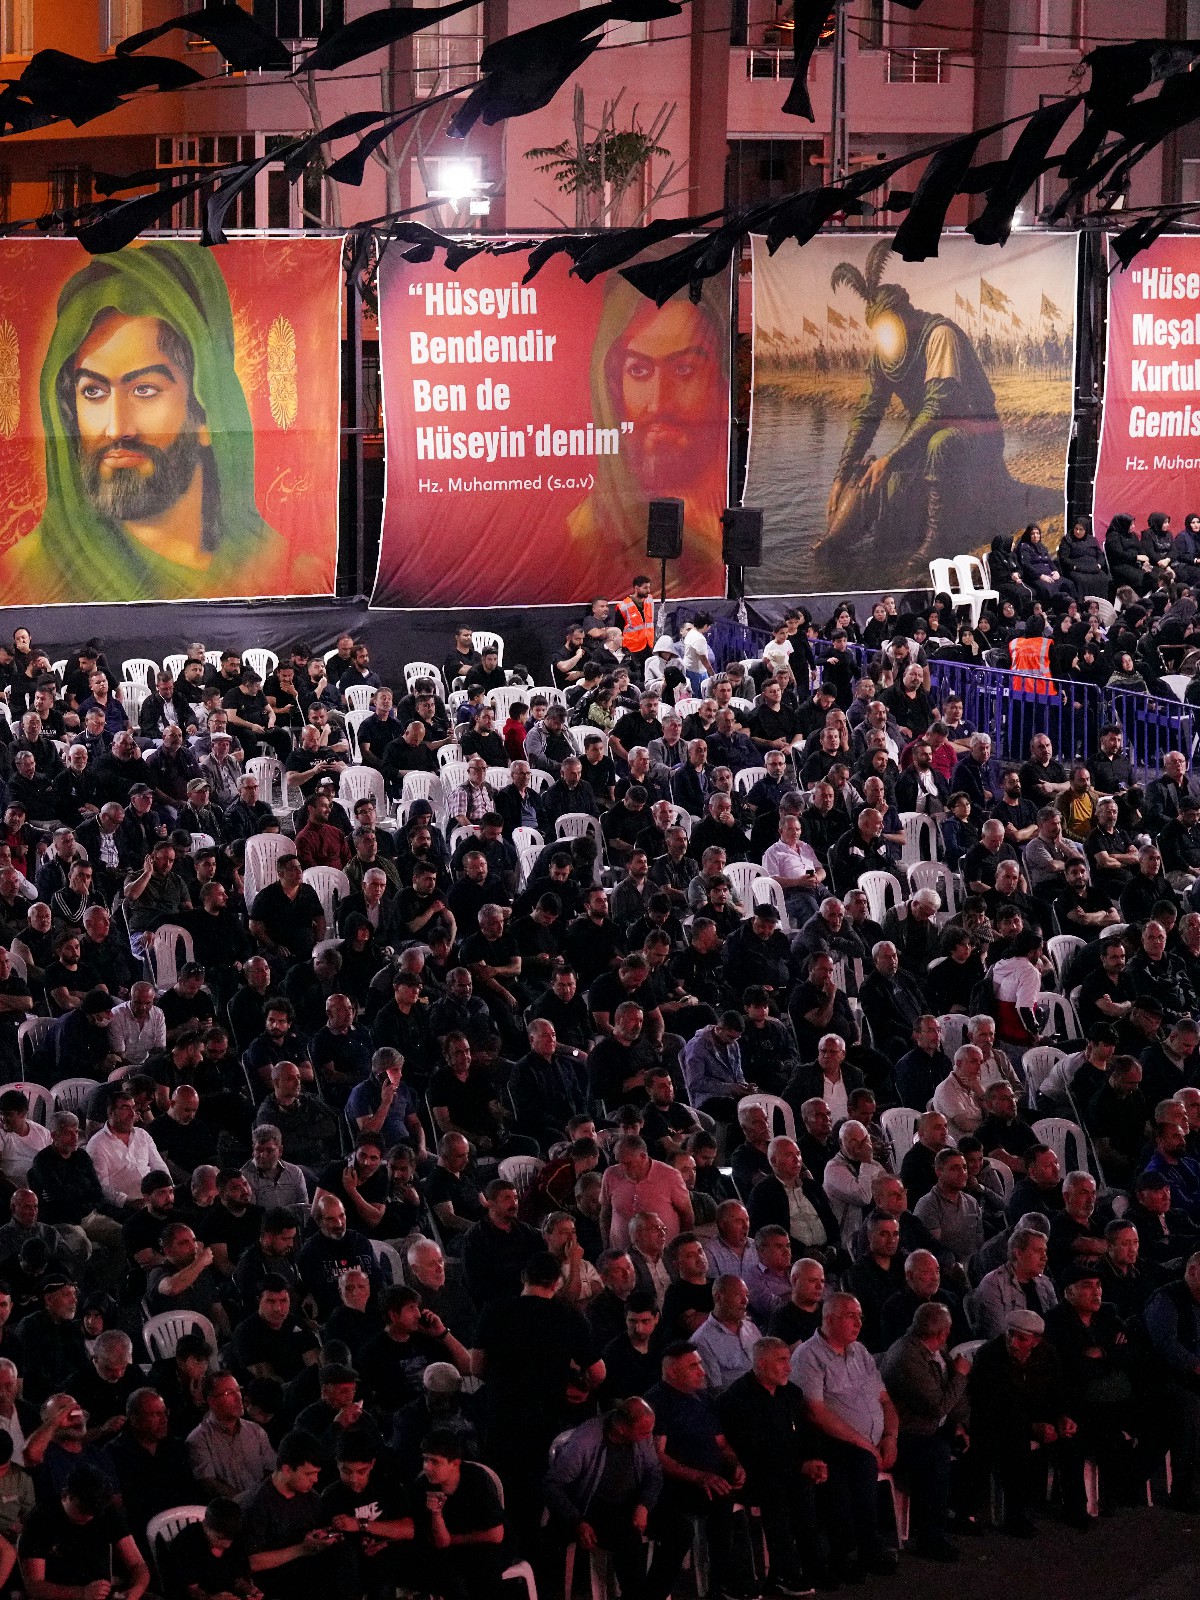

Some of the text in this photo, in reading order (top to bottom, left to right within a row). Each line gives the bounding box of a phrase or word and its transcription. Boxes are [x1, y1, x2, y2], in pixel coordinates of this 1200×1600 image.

[408, 281, 538, 319] “Hüseyin
[409, 329, 557, 365] Bendendir
[412, 377, 511, 413] Ben de
[415, 421, 634, 463] Hüseyin’denim”
[1125, 455, 1149, 471] Hz.
[418, 473, 595, 493] Hz. Muhammed (s.a.v)
